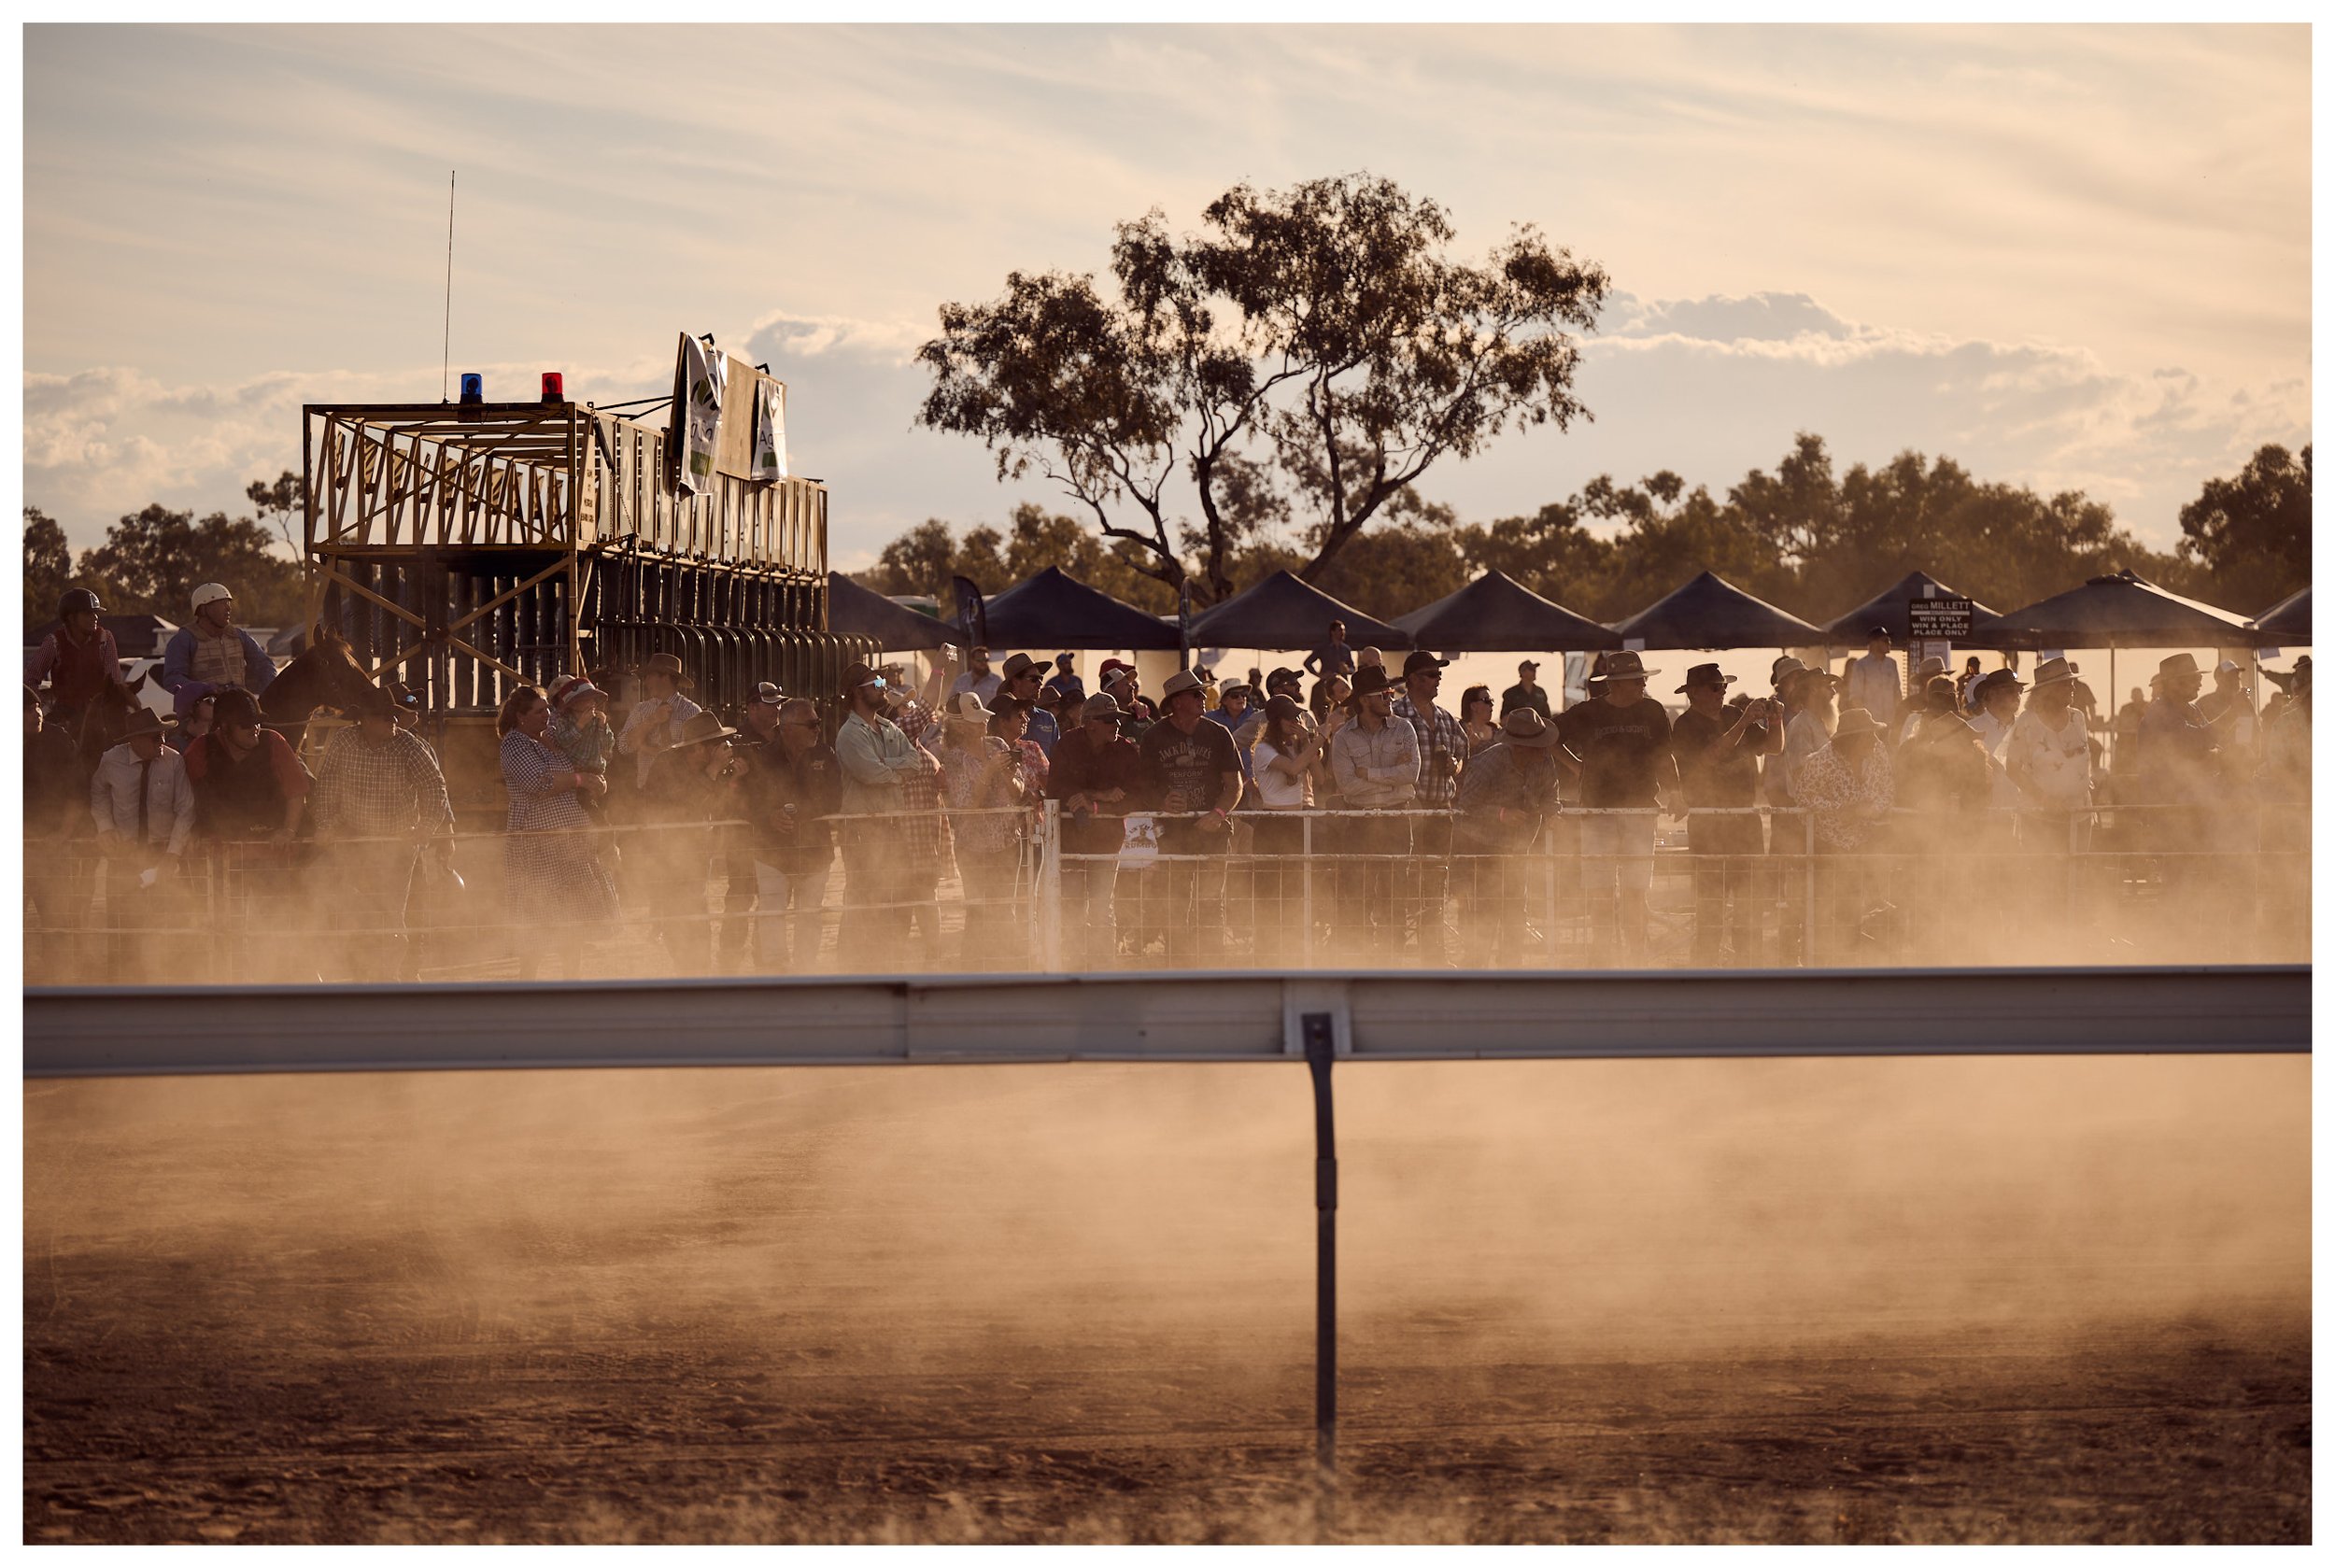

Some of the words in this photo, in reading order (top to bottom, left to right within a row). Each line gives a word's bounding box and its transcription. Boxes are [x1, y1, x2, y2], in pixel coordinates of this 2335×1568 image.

[623, 445, 631, 516] 2
[643, 452, 653, 522] 3
[729, 481, 737, 541] 8
[743, 494, 752, 544] 9
[1930, 601, 1970, 610] MILLETT
[1158, 746, 1180, 762] JACK
